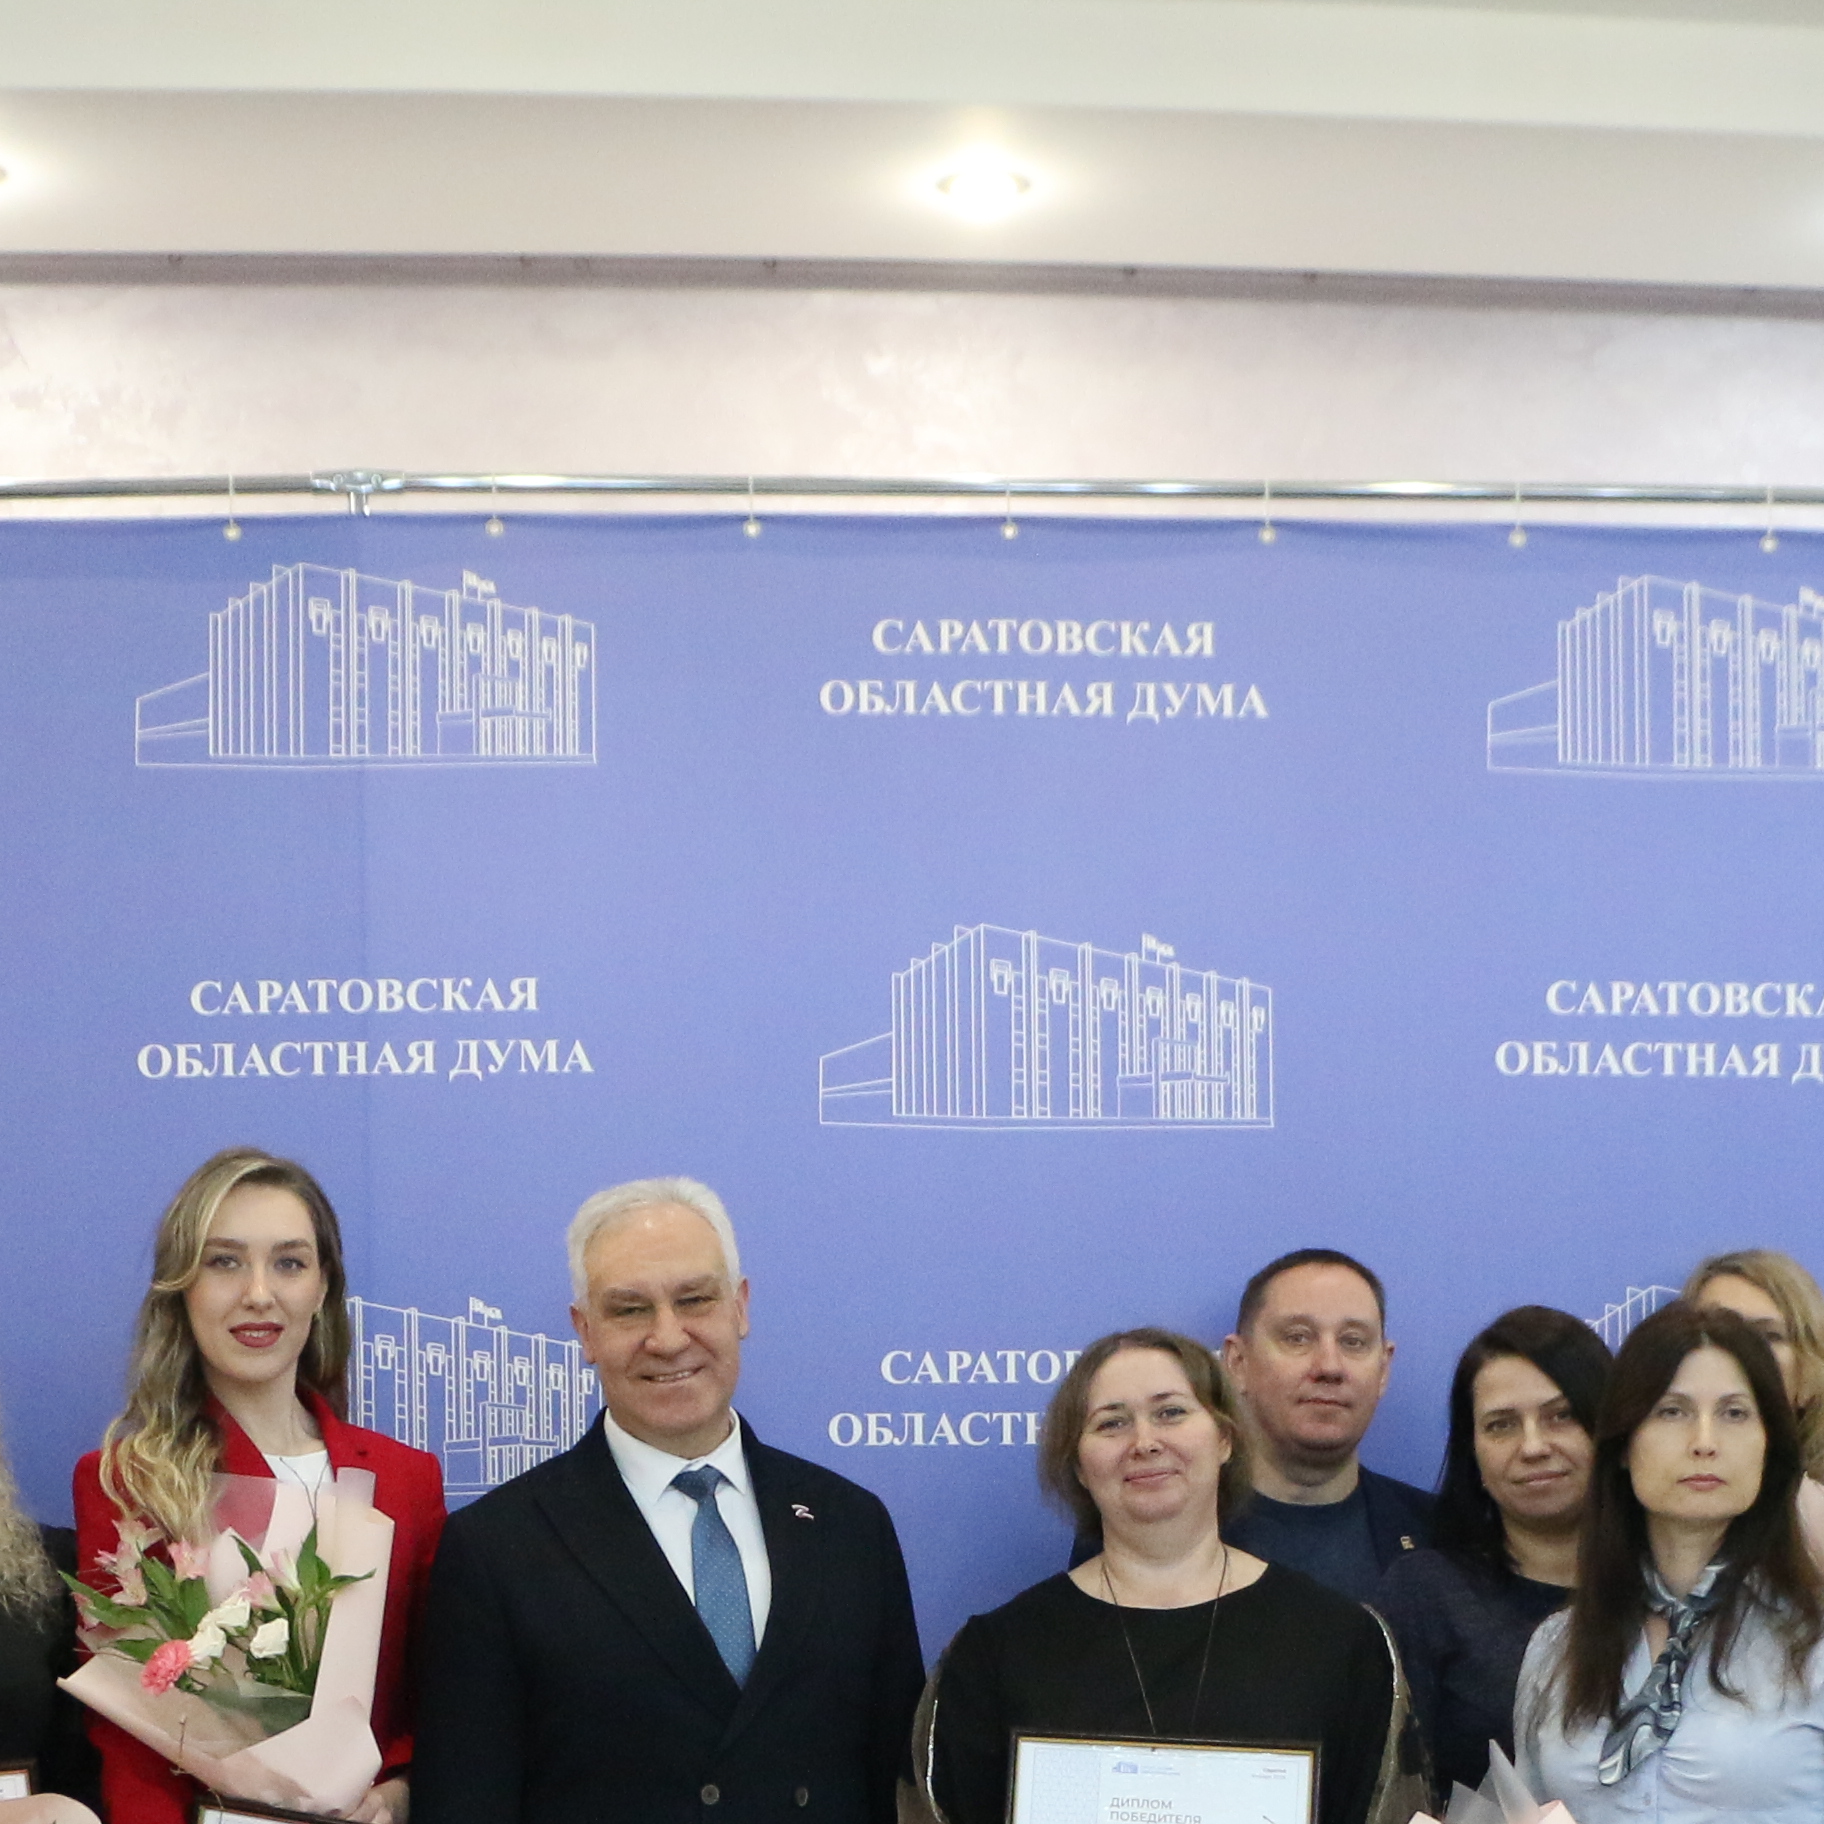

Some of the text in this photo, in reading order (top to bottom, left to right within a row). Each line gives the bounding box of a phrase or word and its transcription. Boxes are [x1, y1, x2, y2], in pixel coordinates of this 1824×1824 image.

[873, 619, 1216, 658] САРАТОВСКАЯ
[820, 680, 1269, 724] ОБЛАСТНАЯ ДУМА
[191, 978, 538, 1016] САРАТОВСКАЯ
[138, 1040, 595, 1083] ОБЛАСТНАЯ ДУМА
[1495, 1042, 1780, 1079] ОБЛАСТНАЯ
[1109, 1796, 1173, 1811] ДИПЛОМ
